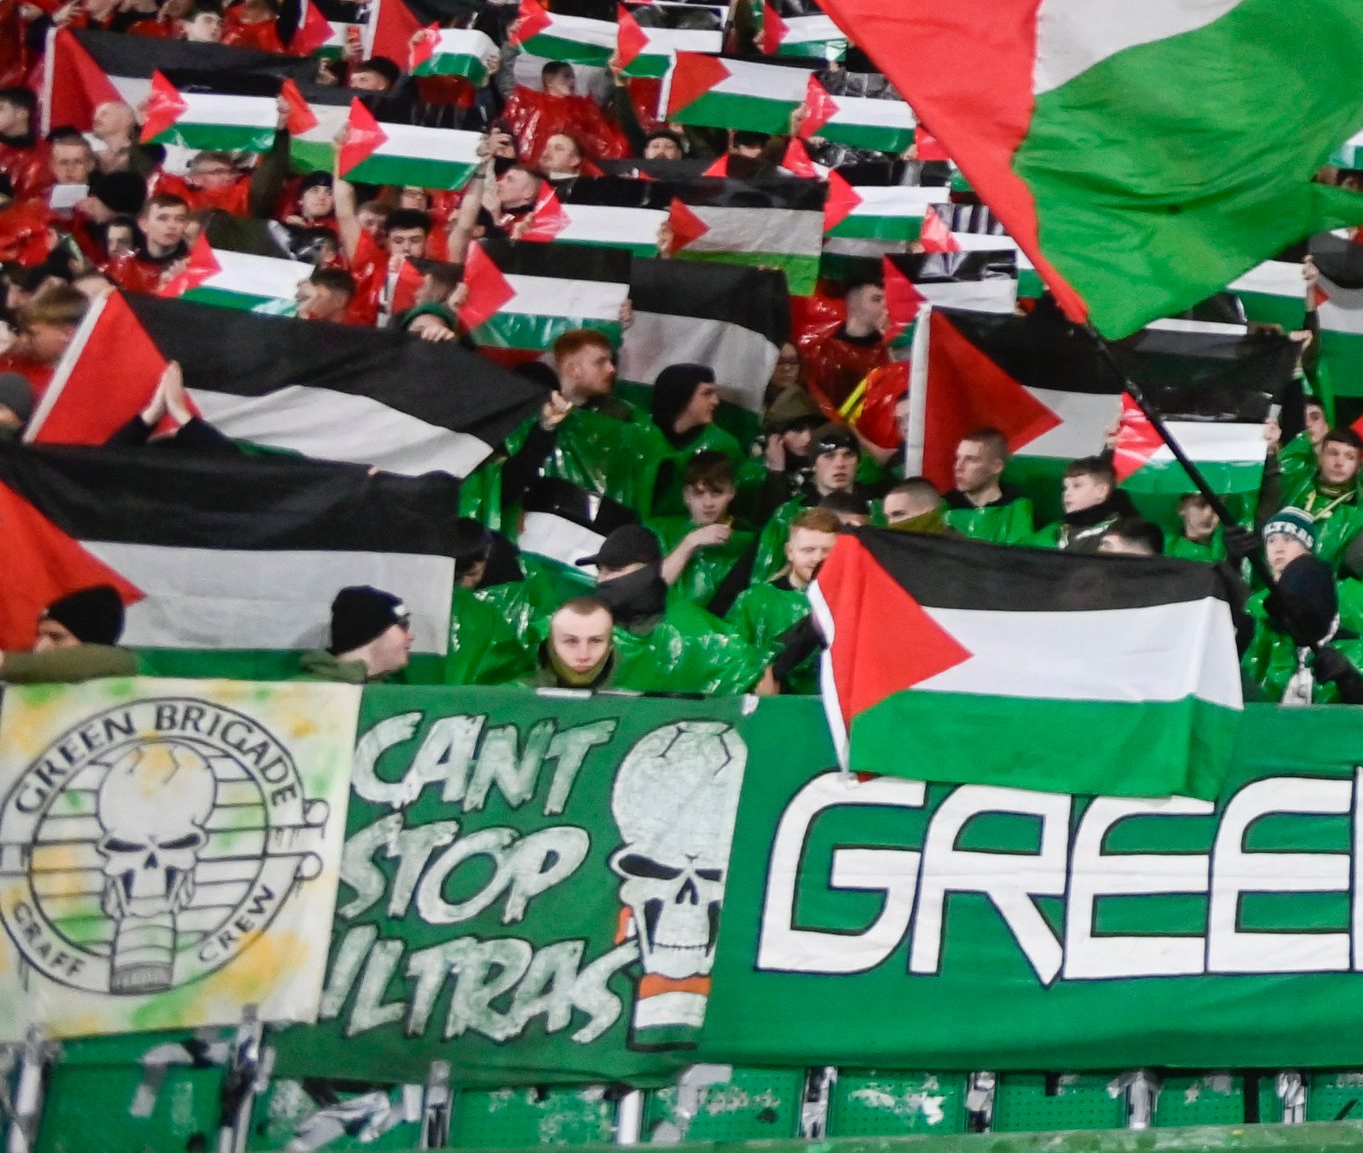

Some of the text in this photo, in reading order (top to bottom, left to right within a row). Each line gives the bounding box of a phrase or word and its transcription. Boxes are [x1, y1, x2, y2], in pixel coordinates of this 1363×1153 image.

[14, 703, 298, 814] GREEN BRIGADE
[351, 710, 620, 816] CANT
[338, 810, 591, 925] STOP
[198, 883, 277, 963] CREW
